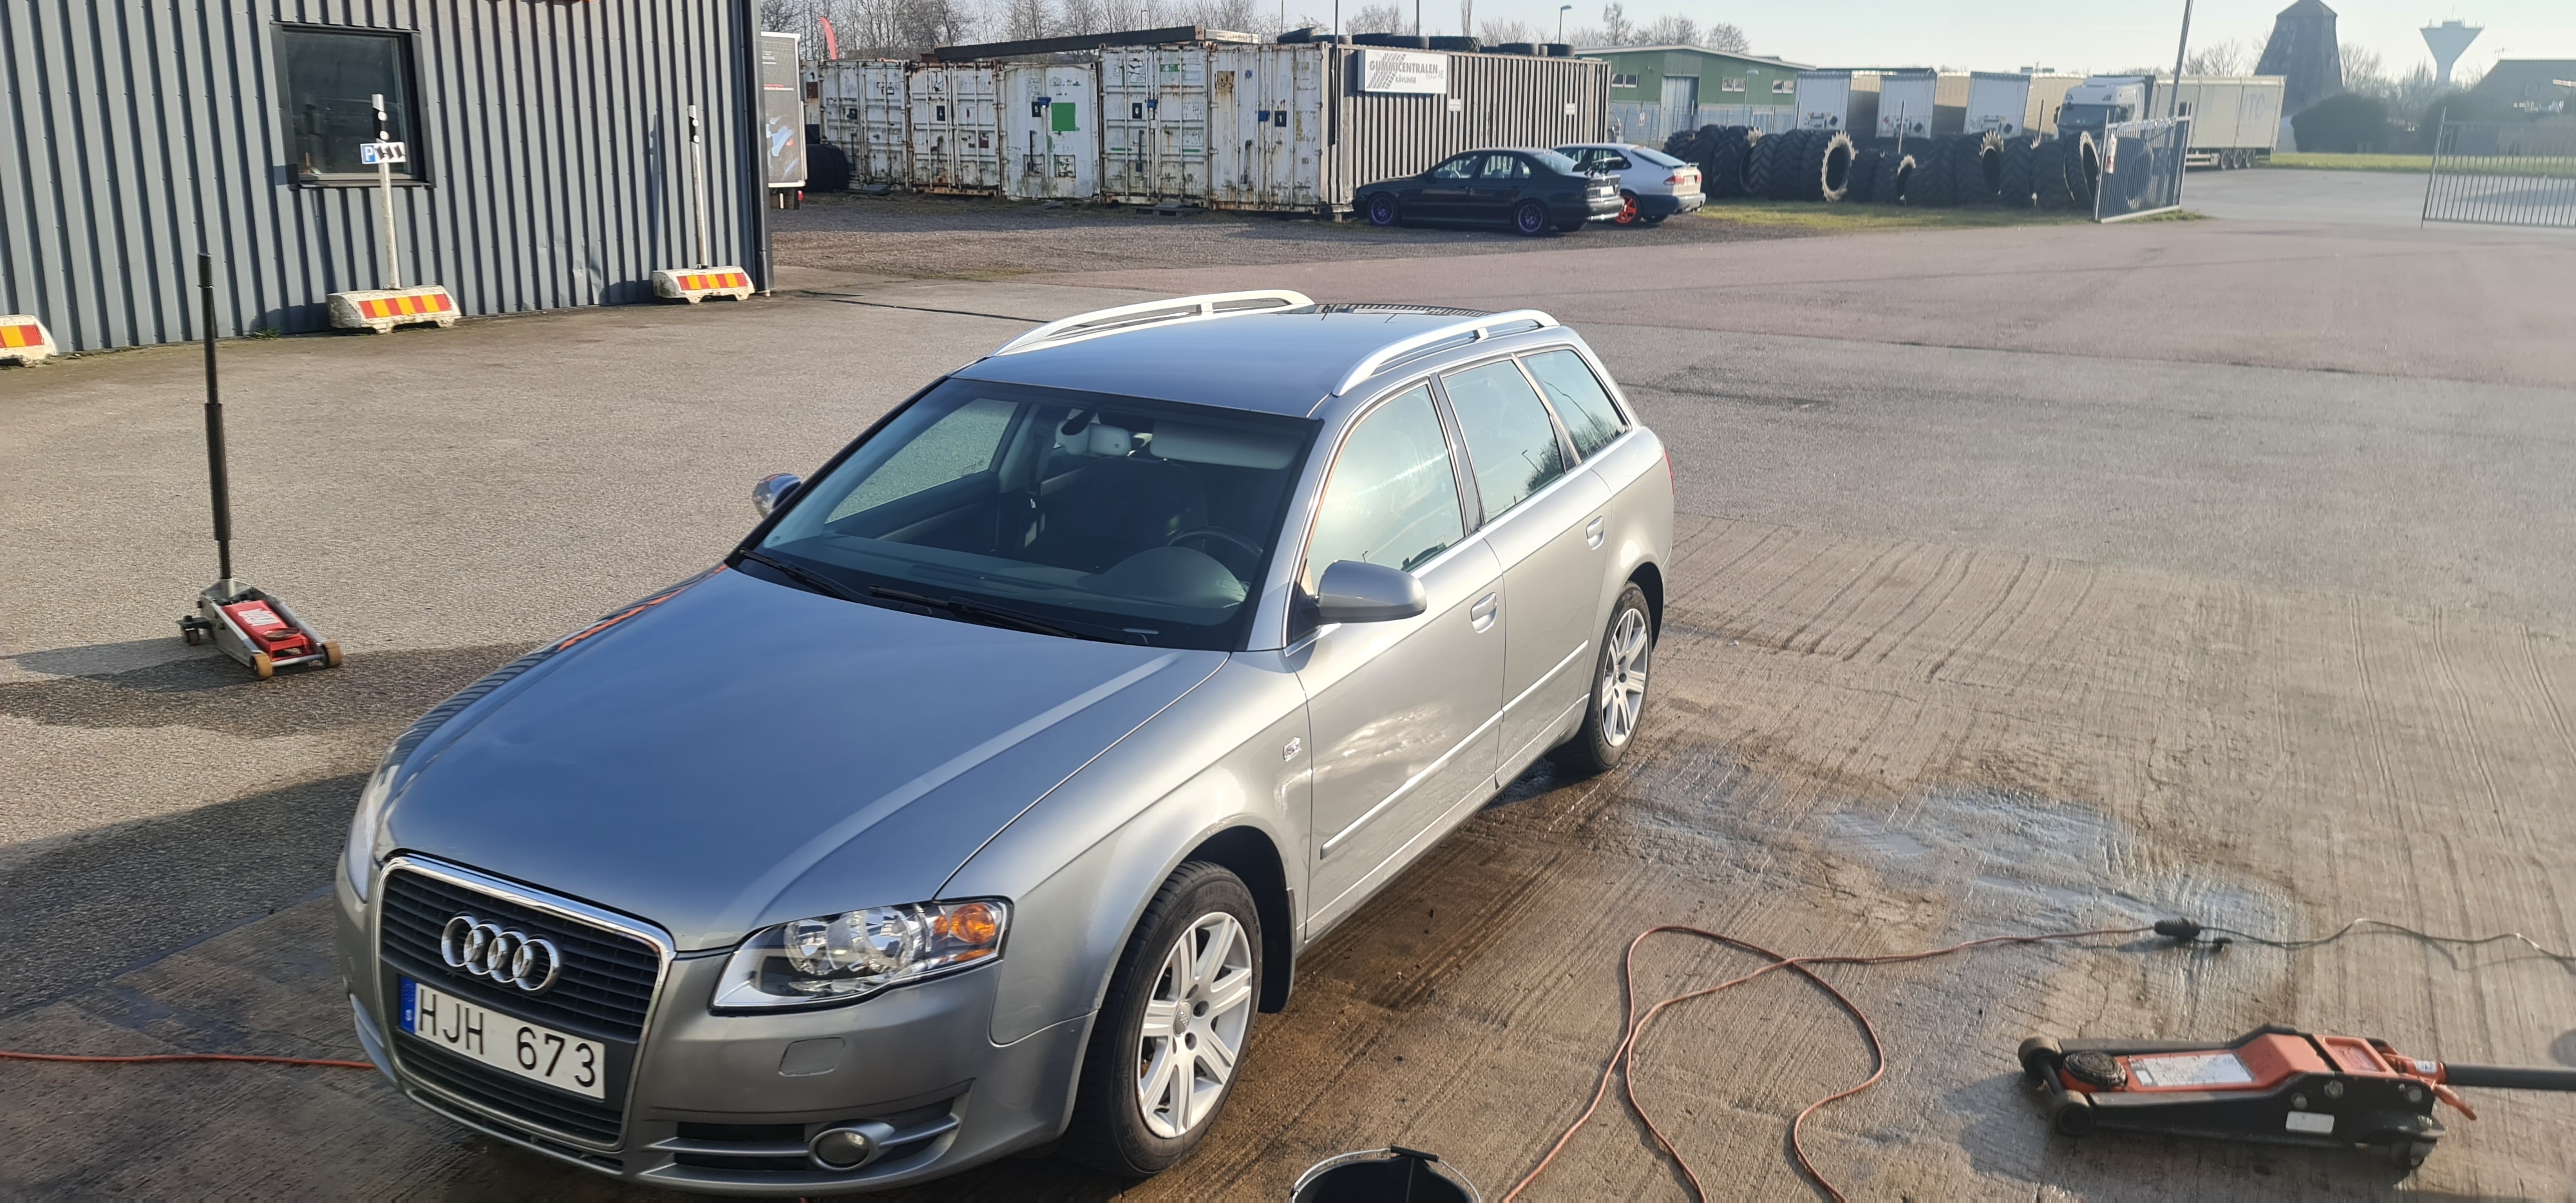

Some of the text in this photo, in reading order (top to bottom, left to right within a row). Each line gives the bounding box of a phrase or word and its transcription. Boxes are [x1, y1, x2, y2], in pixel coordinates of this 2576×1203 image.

[1369, 60, 1438, 74] GUMMICENTRALEN
[419, 989, 596, 1088] HJH 673
